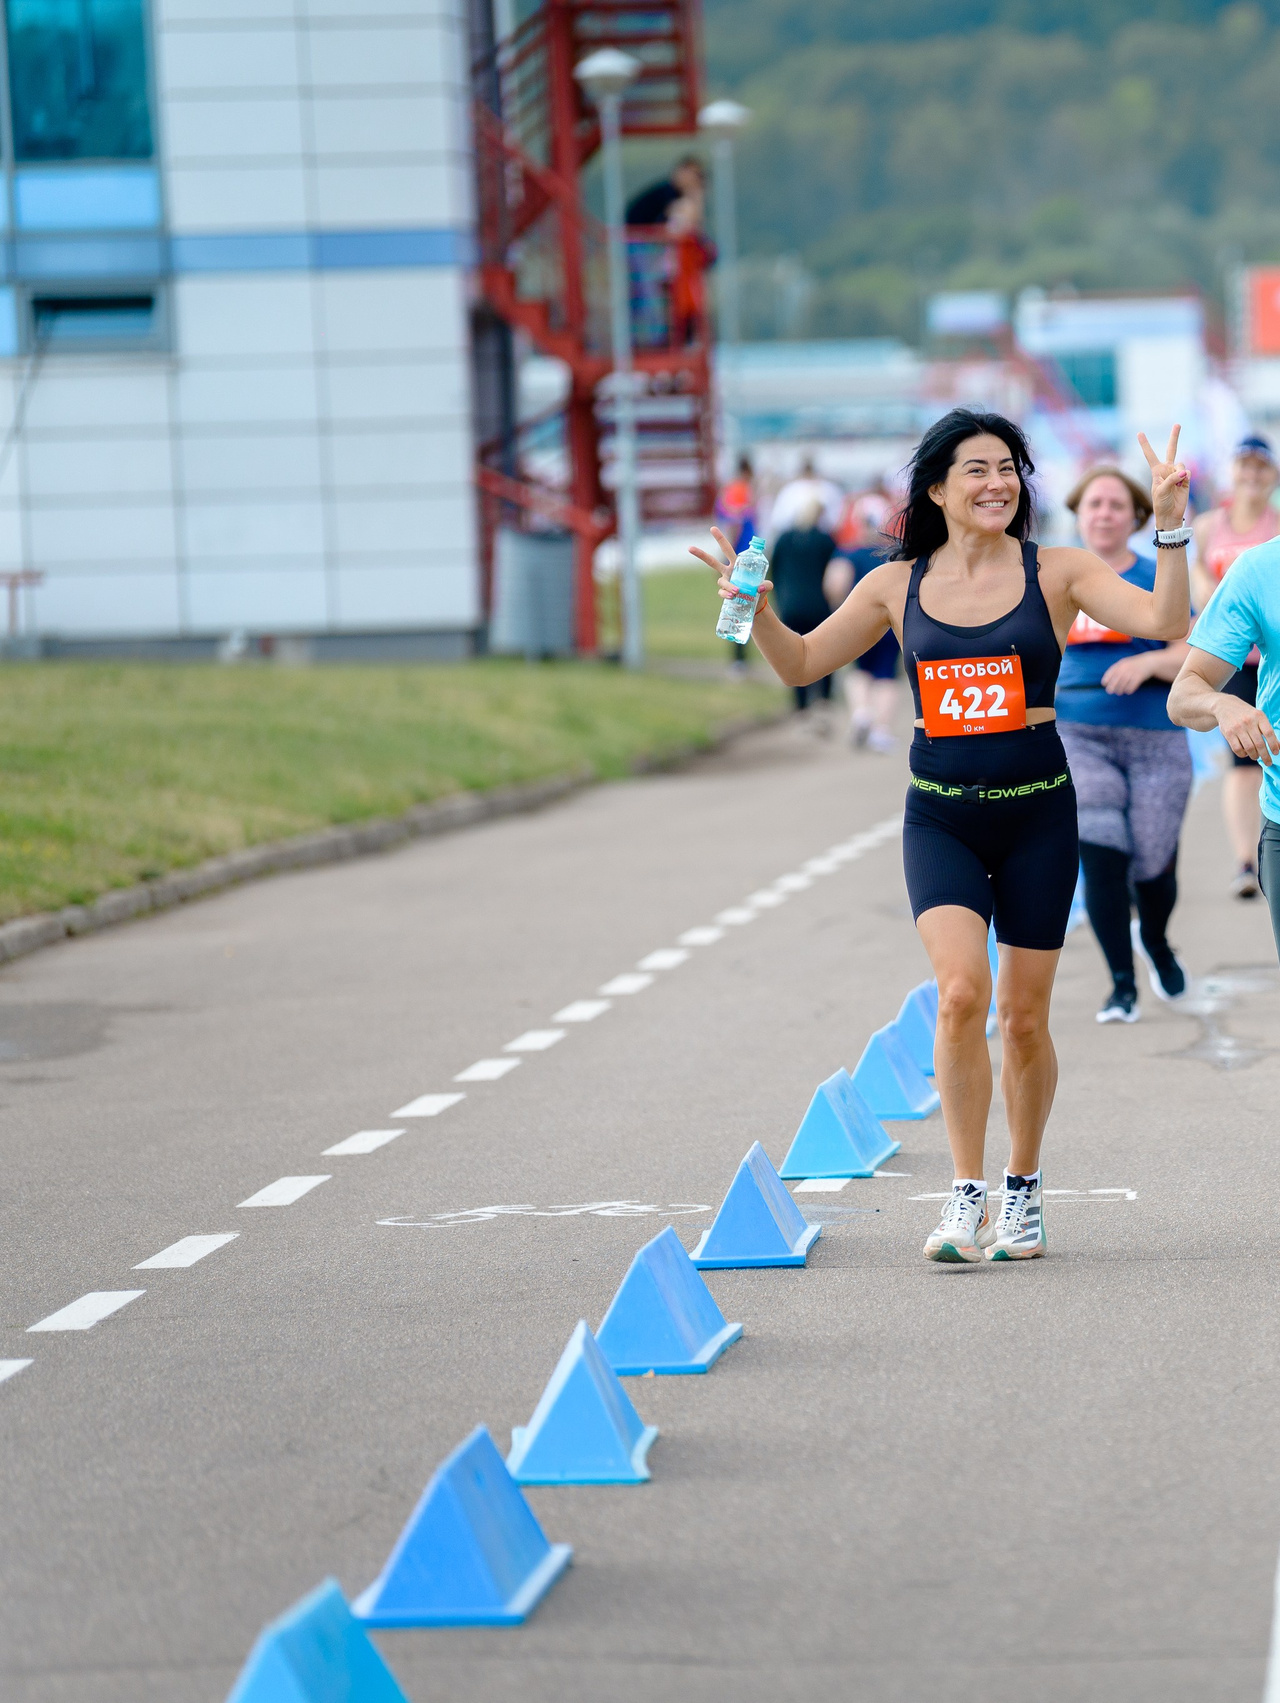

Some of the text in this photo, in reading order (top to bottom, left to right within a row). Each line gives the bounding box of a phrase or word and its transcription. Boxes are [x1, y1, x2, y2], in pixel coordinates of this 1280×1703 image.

[924, 659, 1014, 680] Я С ТОБОЙ
[939, 684, 1008, 720] 422
[962, 724, 985, 733] 10 км
